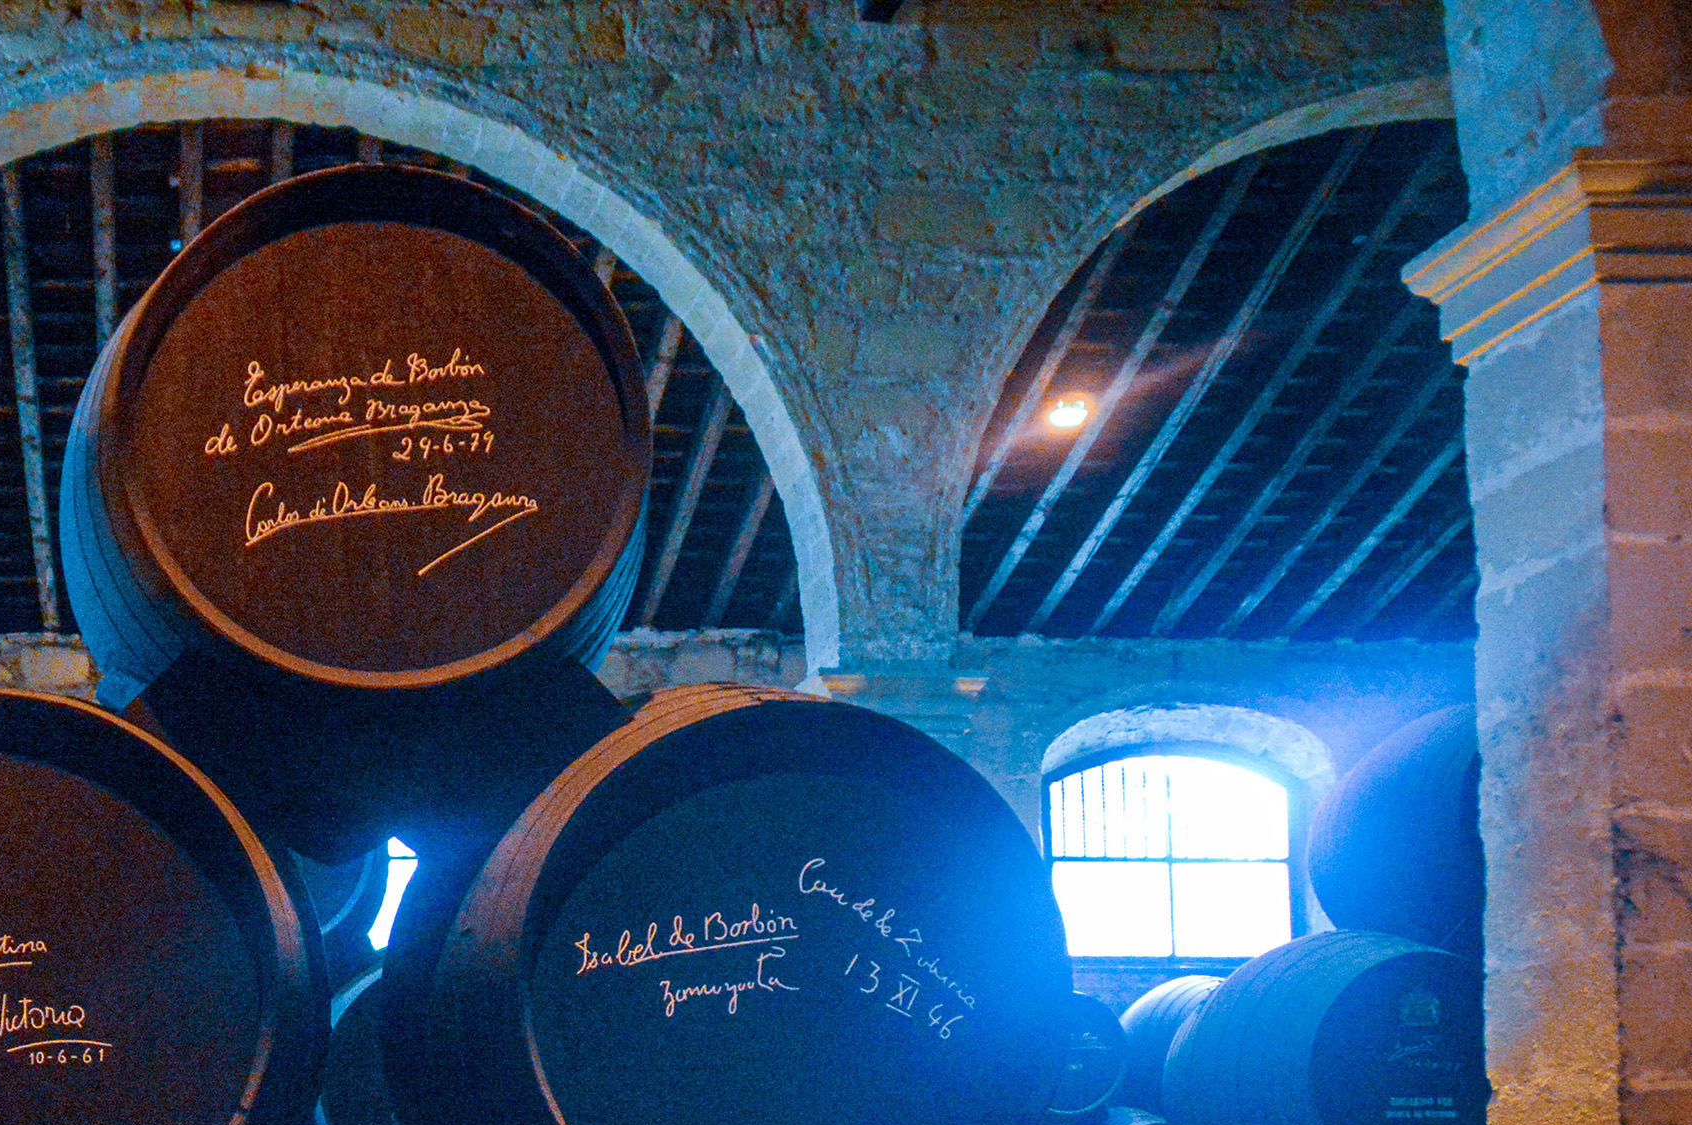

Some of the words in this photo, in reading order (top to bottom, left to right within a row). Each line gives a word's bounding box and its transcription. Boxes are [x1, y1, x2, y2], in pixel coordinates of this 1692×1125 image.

[244, 361, 366, 411] Esperanza
[370, 360, 403, 385] de
[205, 423, 237, 454] de
[246, 482, 299, 542] Carlos
[575, 922, 662, 975] Isabel
[669, 915, 695, 948] de
[704, 903, 797, 941] Borbón
[845, 955, 881, 993] 13
